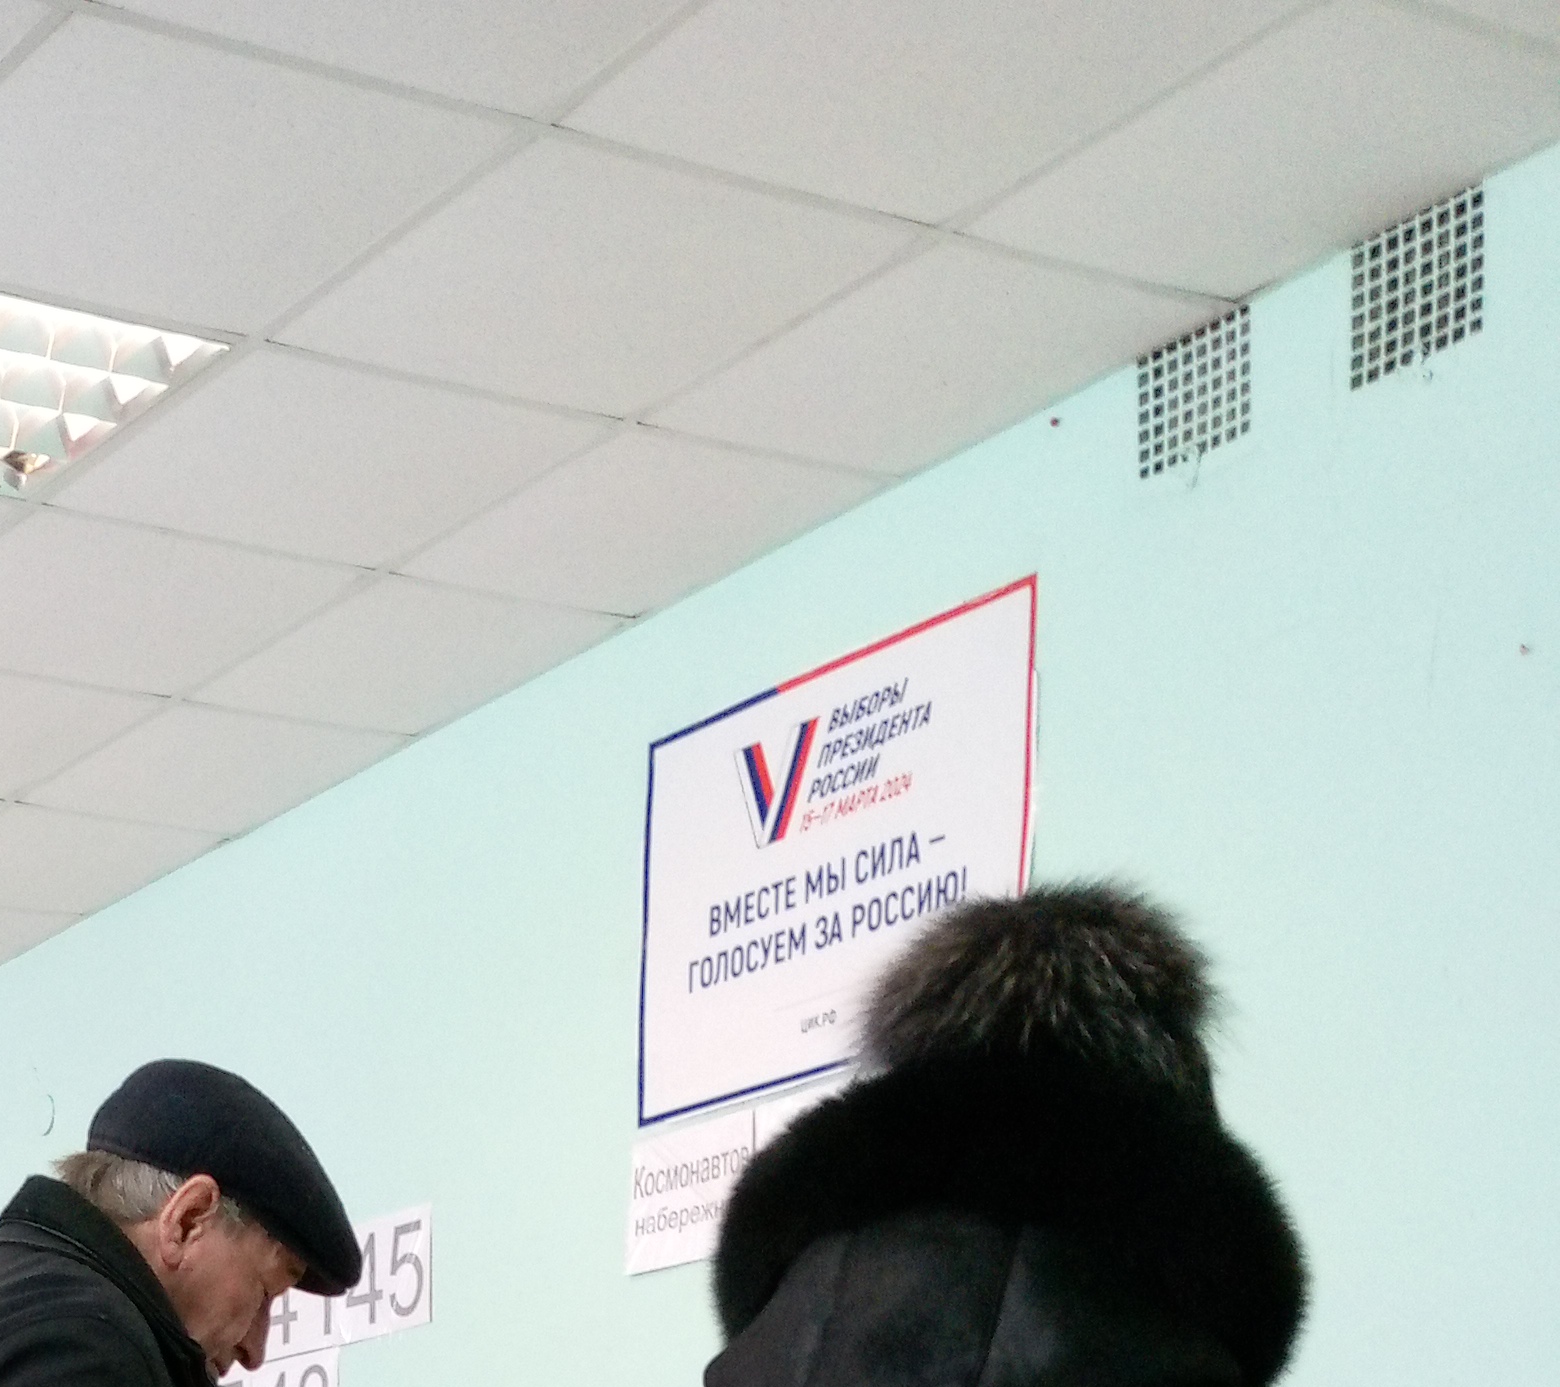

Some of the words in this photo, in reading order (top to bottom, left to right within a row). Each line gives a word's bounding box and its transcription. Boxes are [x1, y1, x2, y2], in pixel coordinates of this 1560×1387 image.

[817, 700, 933, 769] ПРЕЗИДЕНТА
[827, 677, 909, 734] ВЫБОРЫ
[807, 752, 881, 804] РОССИИ
[880, 771, 913, 802] 2024
[709, 876, 797, 938] ВМЕСТЕ
[804, 856, 846, 904] МЫ
[855, 830, 920, 884] СИЛА
[689, 922, 807, 994] ГОЛОСУЕМ
[814, 911, 843, 951] ЗА
[852, 865, 968, 939] РОССИЮ!
[345, 1219, 424, 1325] 45
